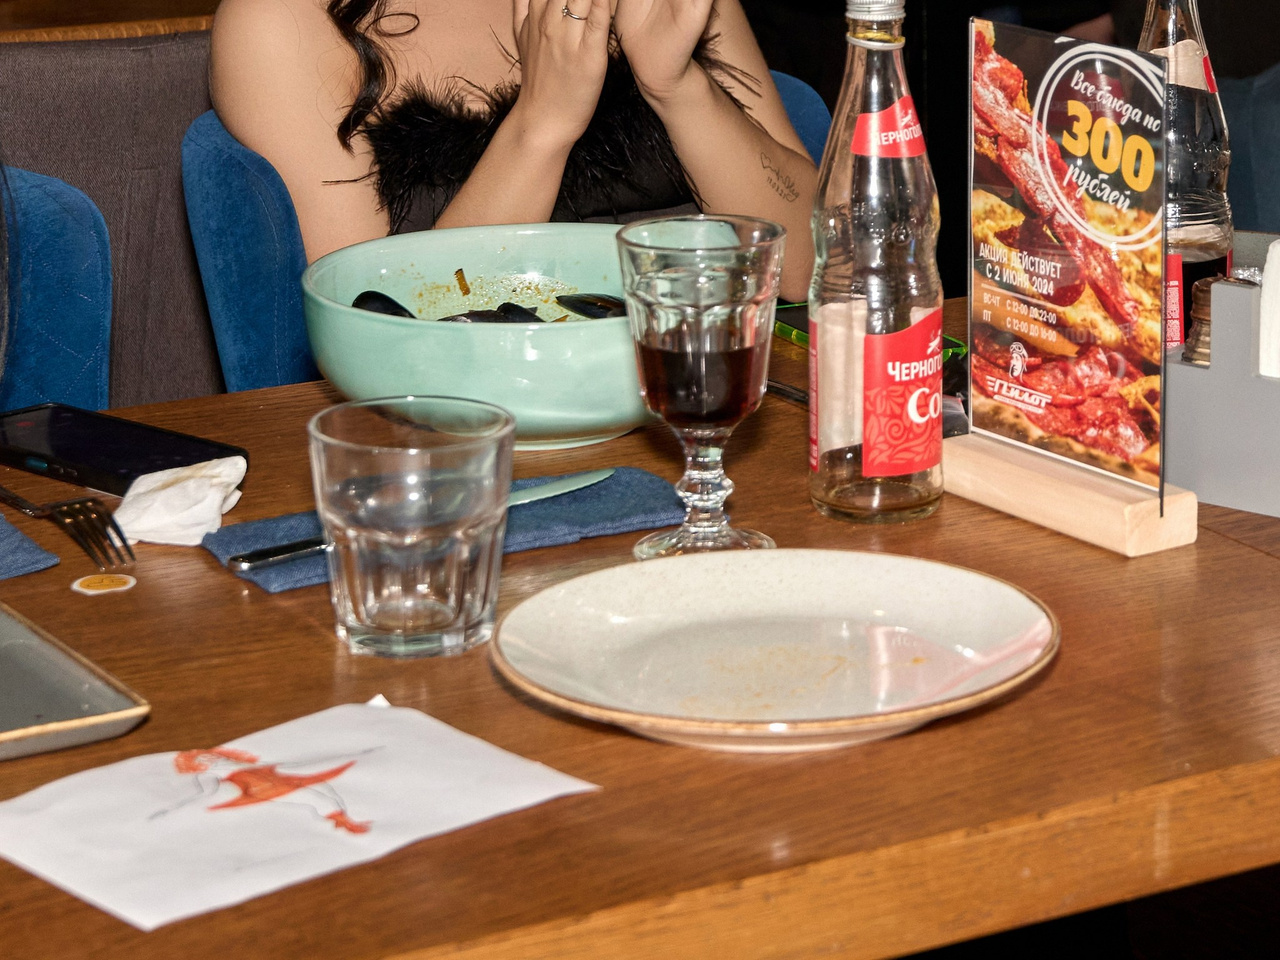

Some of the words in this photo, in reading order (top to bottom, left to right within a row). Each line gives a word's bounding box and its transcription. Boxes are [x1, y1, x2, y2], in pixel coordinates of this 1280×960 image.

[1070, 69, 1096, 97] Все
[1095, 85, 1143, 126] блюда
[1142, 114, 1162, 133] по
[1061, 99, 1156, 193] 300
[1062, 163, 1132, 214] рублей
[979, 242, 1008, 264] АКЦИЯ
[1011, 251, 1062, 279] ДЕЙСТВУЕТ
[986, 262, 993, 278] С
[994, 265, 1001, 281] 2
[1003, 268, 1030, 289] ИЮНЯ
[1032, 276, 1055, 296] 2024
[983, 292, 1001, 307] ВС-ЧТ
[1006, 299, 1012, 310] С
[1012, 302, 1028, 316] 12-00
[1040, 309, 1057, 325] 22-00
[983, 309, 992, 322] ПТ
[1006, 316, 1012, 328] С
[1013, 319, 1029, 334] 12-00
[1029, 323, 1039, 337] ДО
[990, 377, 1053, 408] ПИЛОТ
